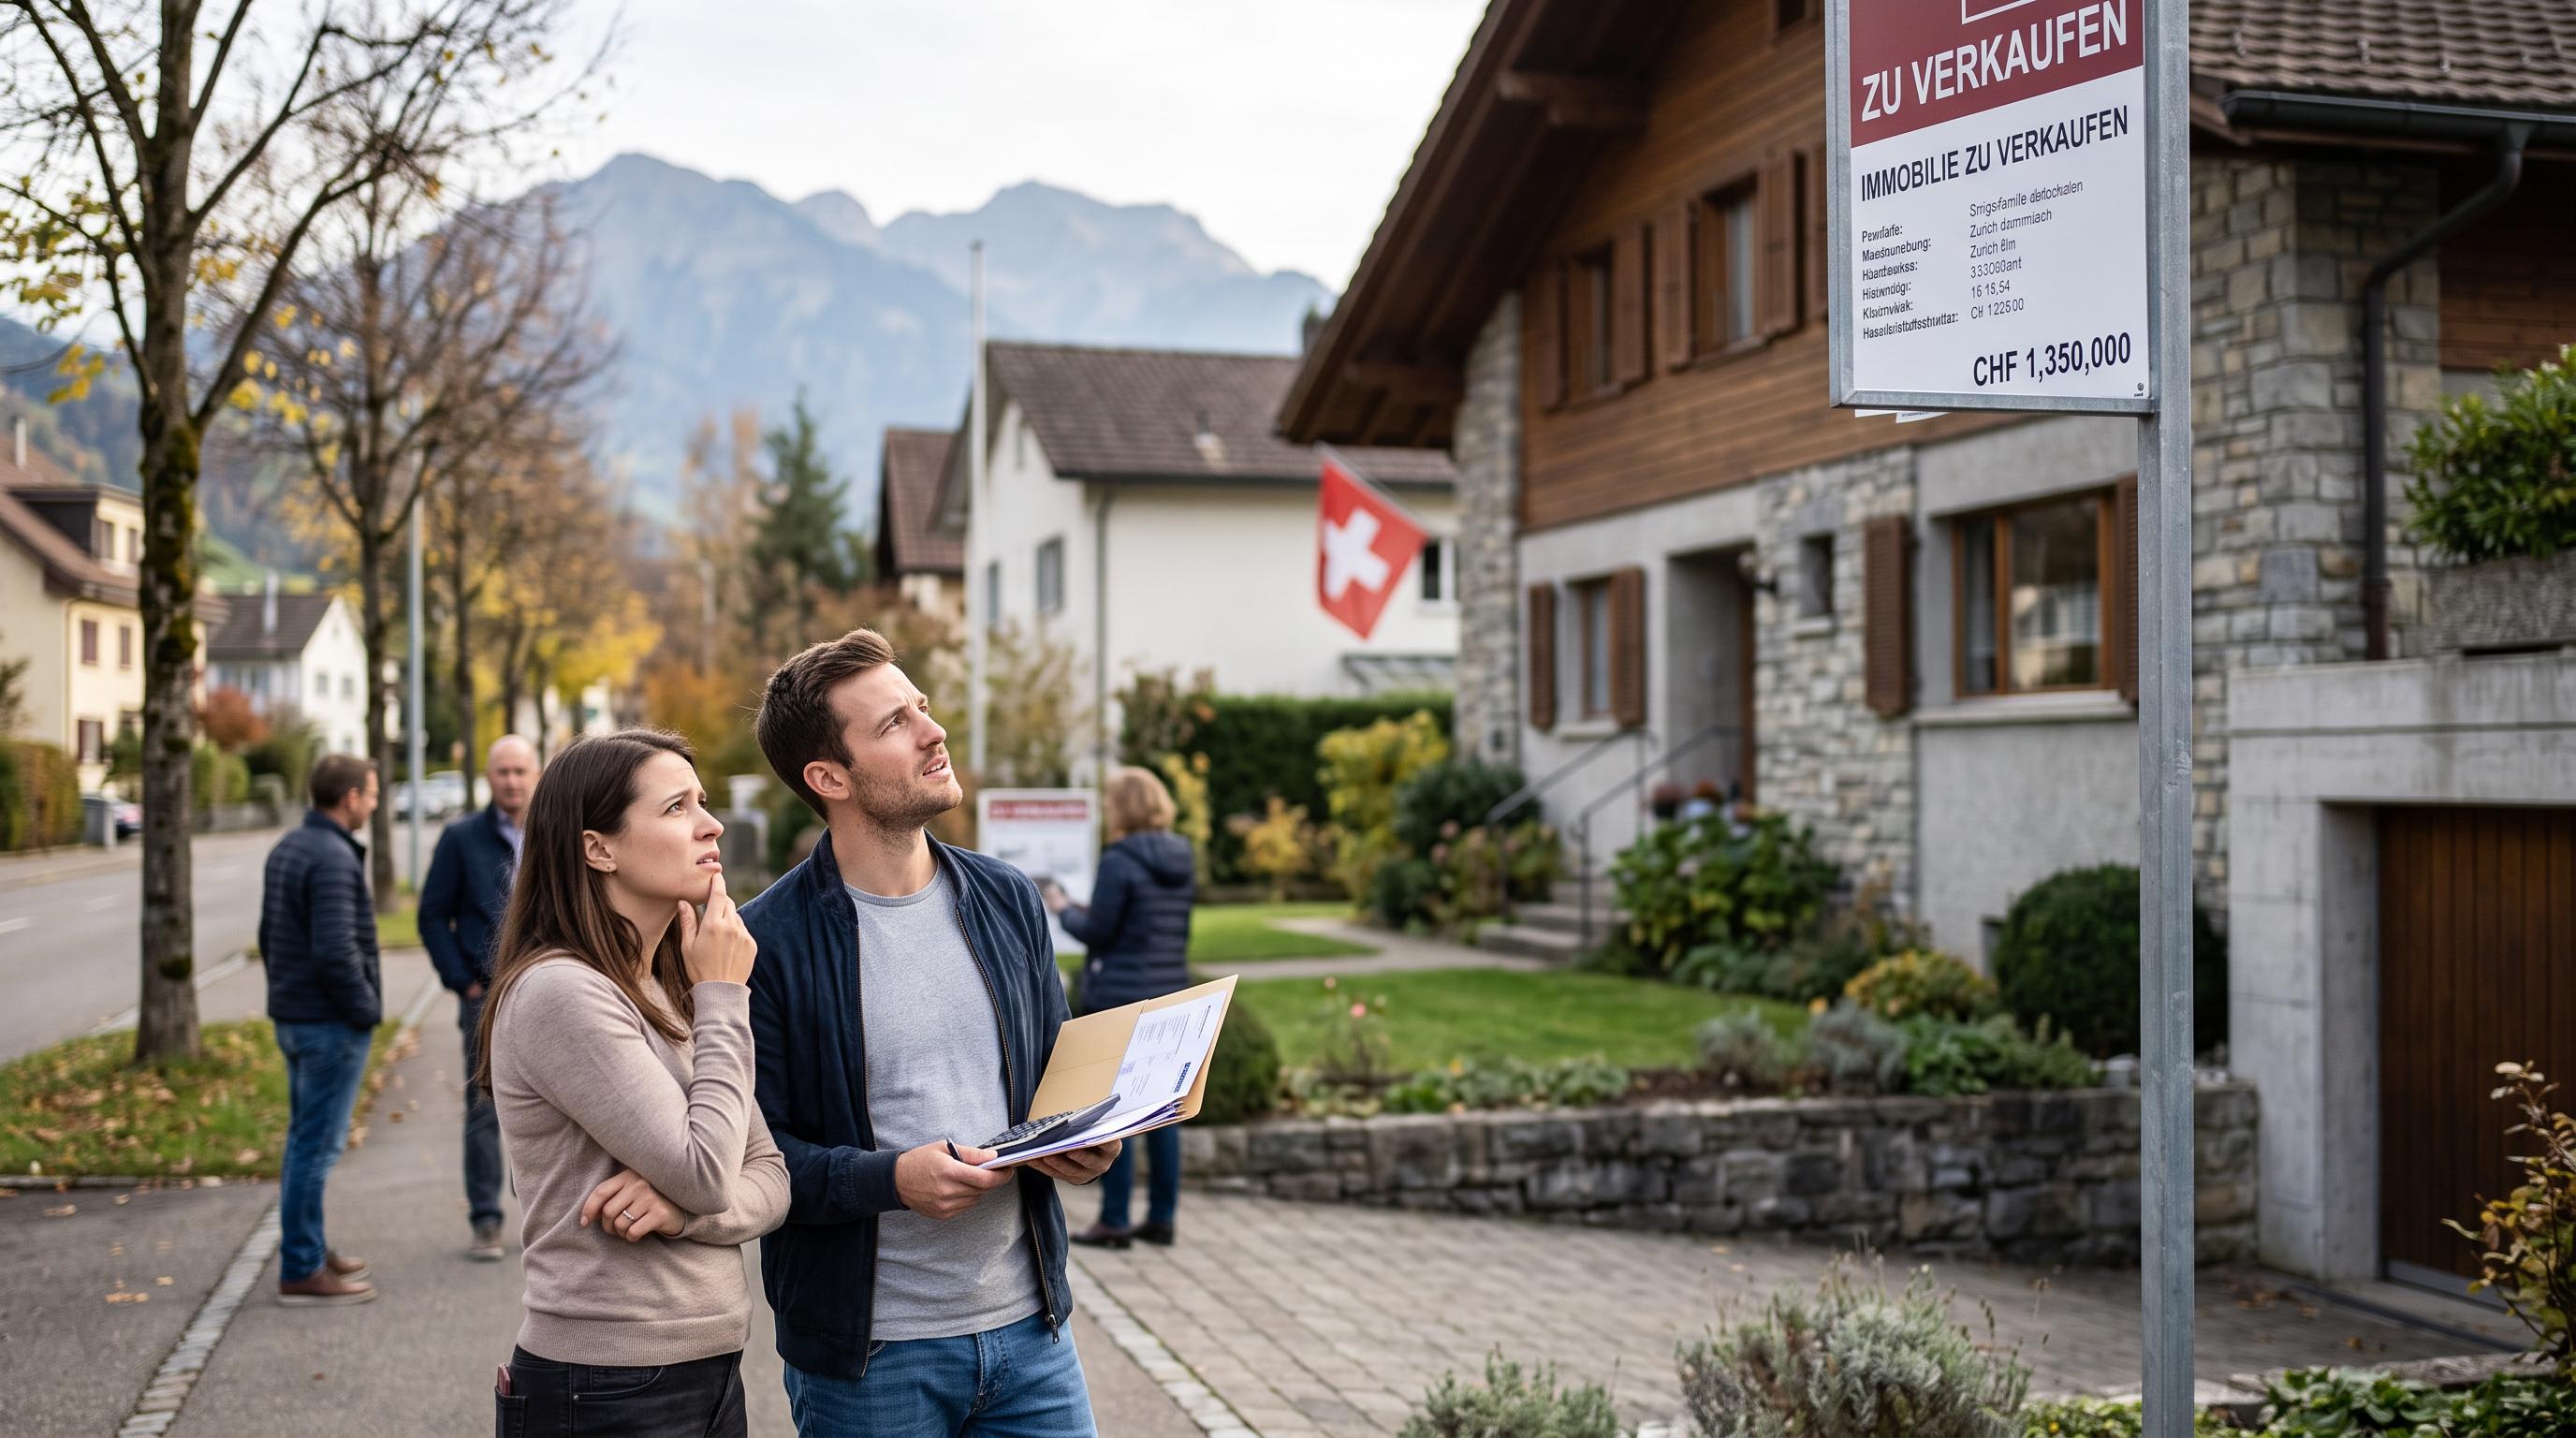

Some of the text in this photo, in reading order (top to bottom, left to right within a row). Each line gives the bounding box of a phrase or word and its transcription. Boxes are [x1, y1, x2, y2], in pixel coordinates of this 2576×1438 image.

[1861, 0, 2127, 123] ZU VERKAUFEN
[1861, 105, 2129, 201] IMMOBILIE ZU VERKAUFEN
[1970, 305, 1983, 319] CH
[1973, 331, 2131, 387] CHF 1,350,000
